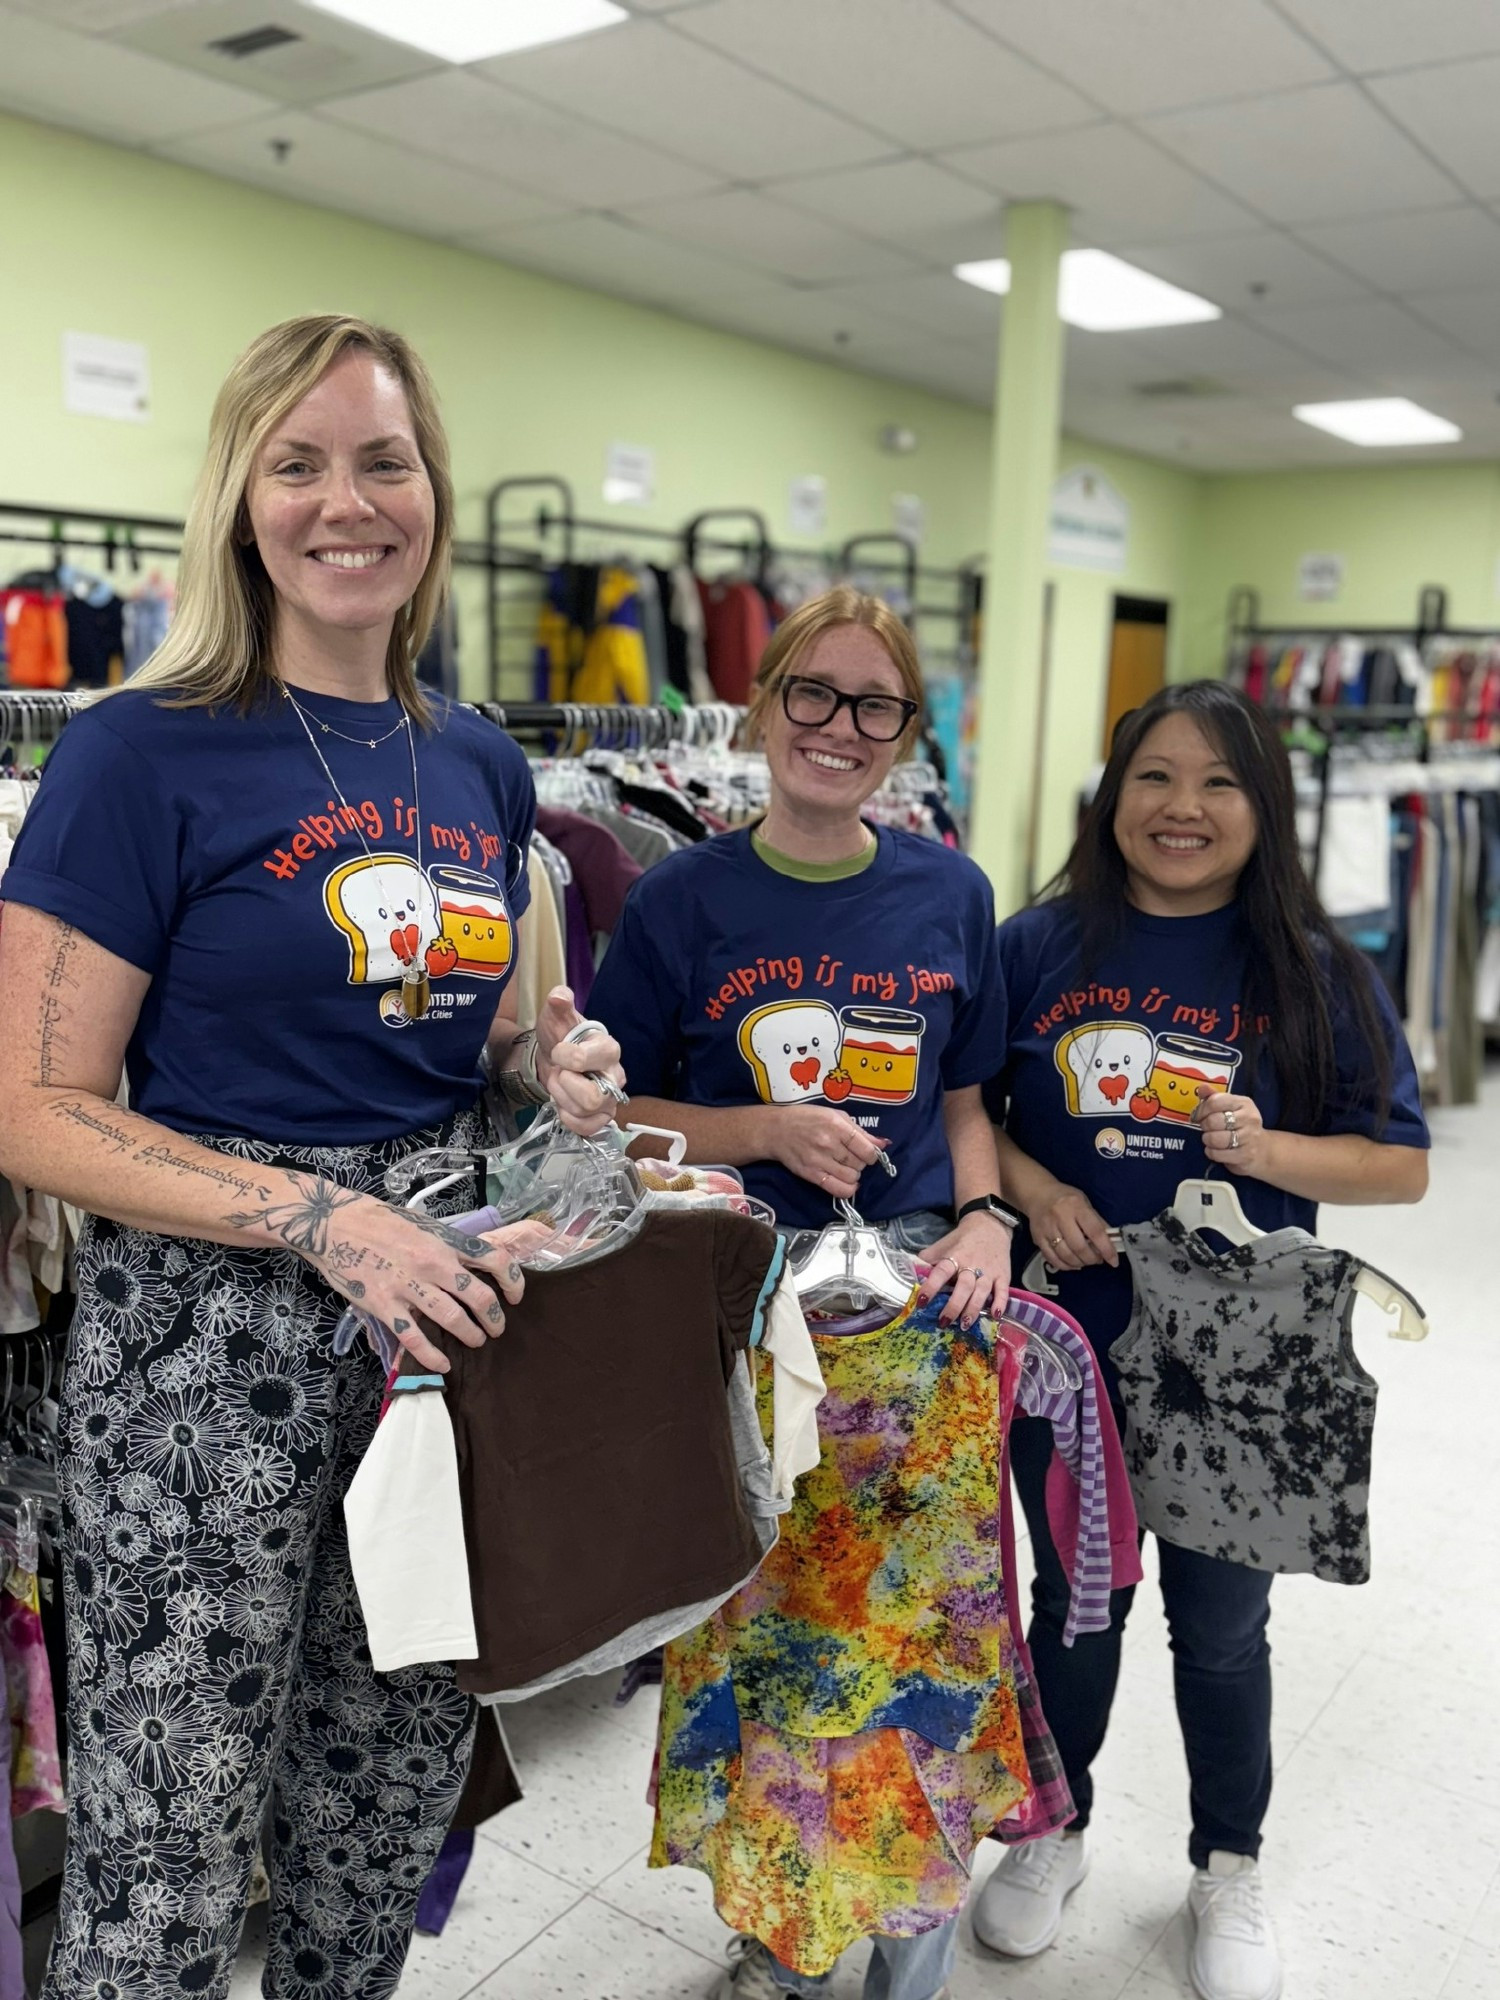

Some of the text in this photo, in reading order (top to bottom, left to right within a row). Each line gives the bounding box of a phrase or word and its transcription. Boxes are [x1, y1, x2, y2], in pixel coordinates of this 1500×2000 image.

[263, 797, 501, 880] Helping is my jam
[704, 954, 955, 1021] Helping is my jam
[428, 993, 477, 1007] ITED WAY
[431, 1010, 453, 1020] Cities
[1033, 983, 1131, 1035] Helping
[1141, 987, 1170, 1013] is
[1172, 1004, 1219, 1033] my
[858, 1116, 880, 1128] WAY
[1126, 1134, 1185, 1150] UNITED WAY
[1126, 1148, 1164, 1160] Fox Cities
